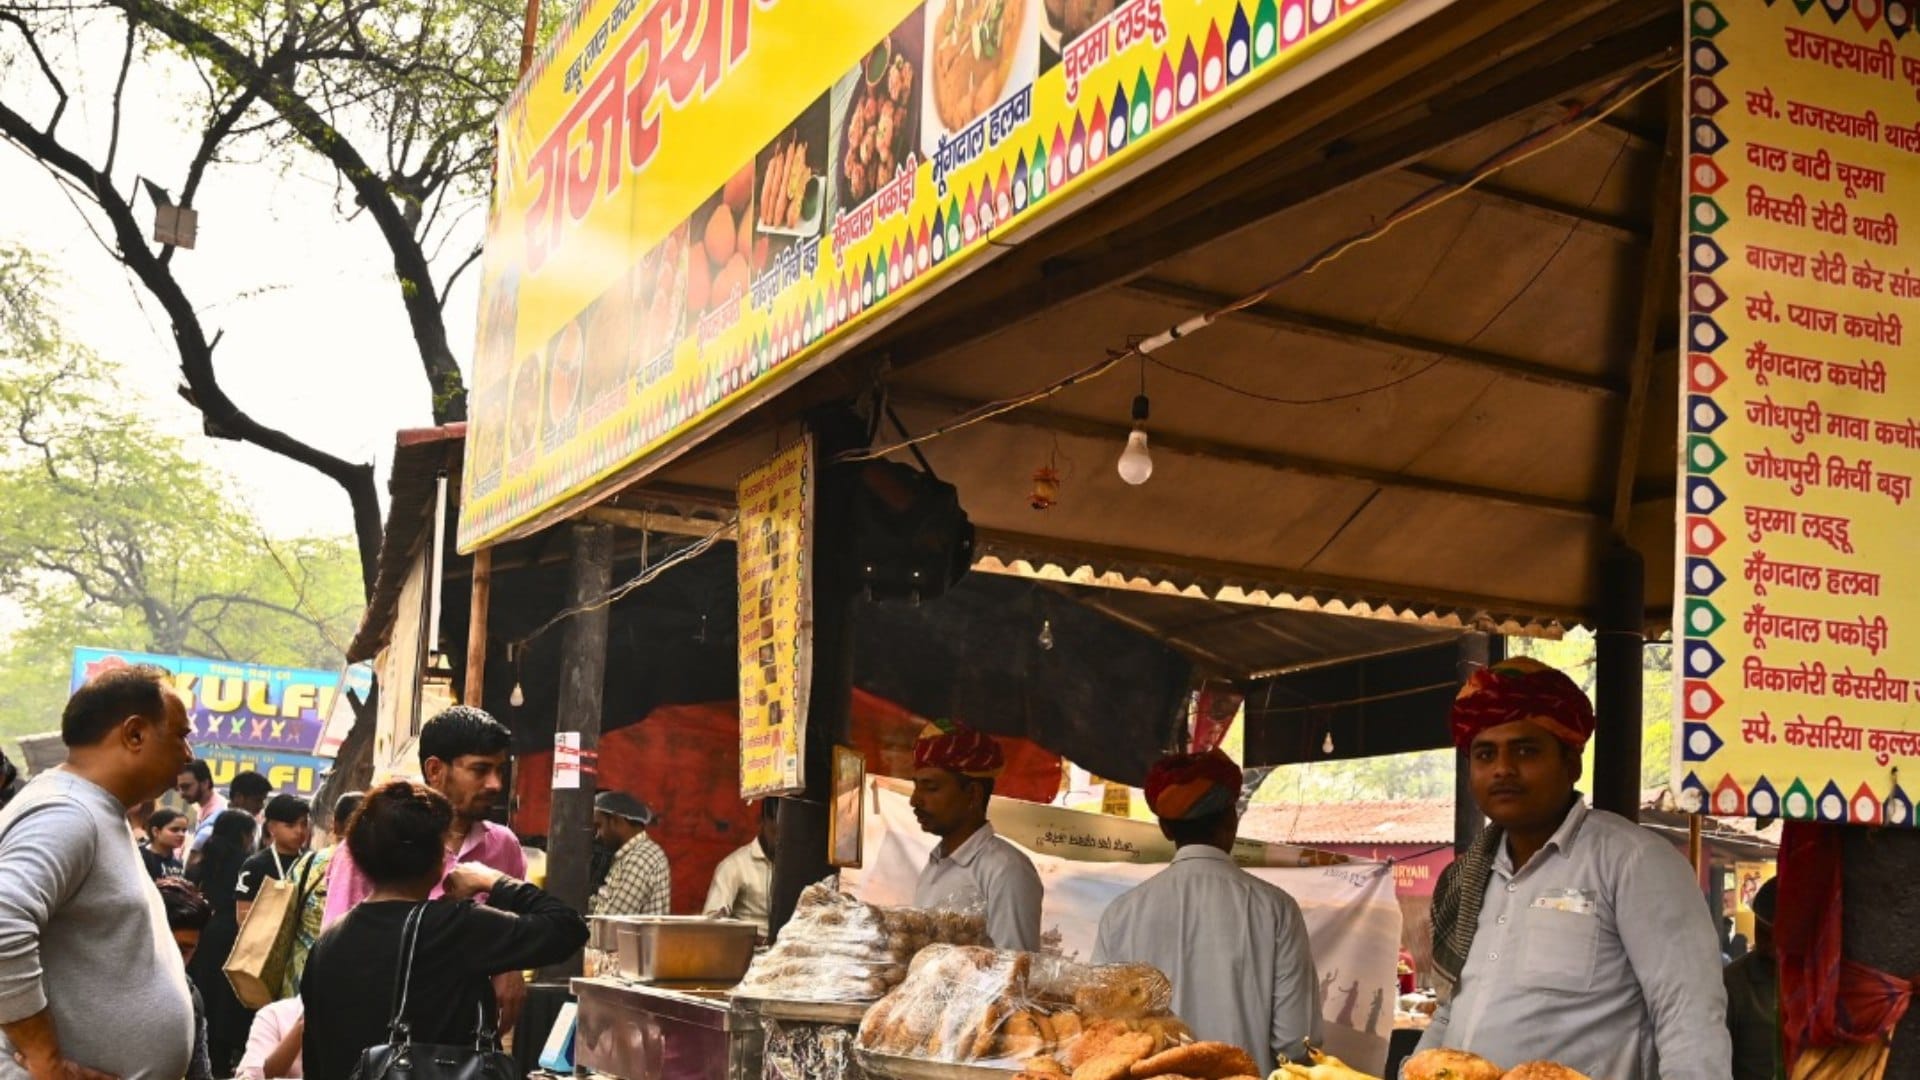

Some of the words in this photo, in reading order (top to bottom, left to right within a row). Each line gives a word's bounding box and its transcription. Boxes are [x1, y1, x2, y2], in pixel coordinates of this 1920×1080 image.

[1064, 20, 1110, 101] चुरमा
[1784, 26, 1896, 81] राजस्थानी
[989, 83, 1033, 147] हलवा
[1746, 86, 1781, 119] स्पे.
[1787, 100, 1879, 143] राजस्थानी
[1746, 142, 1788, 172] दाल
[1792, 148, 1831, 182] बाटी
[1836, 162, 1885, 199] चूरमा
[1746, 185, 1807, 227] मिस्सी
[1811, 200, 1848, 235] रोटी
[1853, 212, 1898, 246] थाली
[1745, 245, 1806, 278] बाजरा
[1811, 250, 1847, 285] रोटी
[1852, 259, 1885, 293] केर
[1745, 291, 1781, 323] स्पे.
[1787, 303, 1838, 334] प्याज
[1843, 312, 1902, 346] कचोरी
[1745, 340, 1823, 386] मूँगदाल
[1827, 359, 1886, 393] कचोरी
[1745, 394, 1821, 444] जोधपुरी
[1827, 413, 1870, 441] मावा
[1744, 446, 1821, 496] जोधपुरी
[1826, 455, 1872, 492] मिर्ची
[1876, 472, 1912, 505] बड़ा
[1744, 506, 1797, 543] चुरमा
[1744, 549, 1822, 596] मूँगदाल
[1826, 568, 1880, 597] हलवा
[1743, 603, 1822, 649] मूँगदाल
[1826, 615, 1888, 656] पकोड़ी
[174, 672, 336, 721] KULFI
[1743, 656, 1827, 695] बिकानेरी
[1832, 666, 1909, 702] केसरीया
[1742, 711, 1777, 744] स्पे.
[1784, 714, 1864, 751] केसरिया
[1868, 729, 1920, 767] कुल्ल
